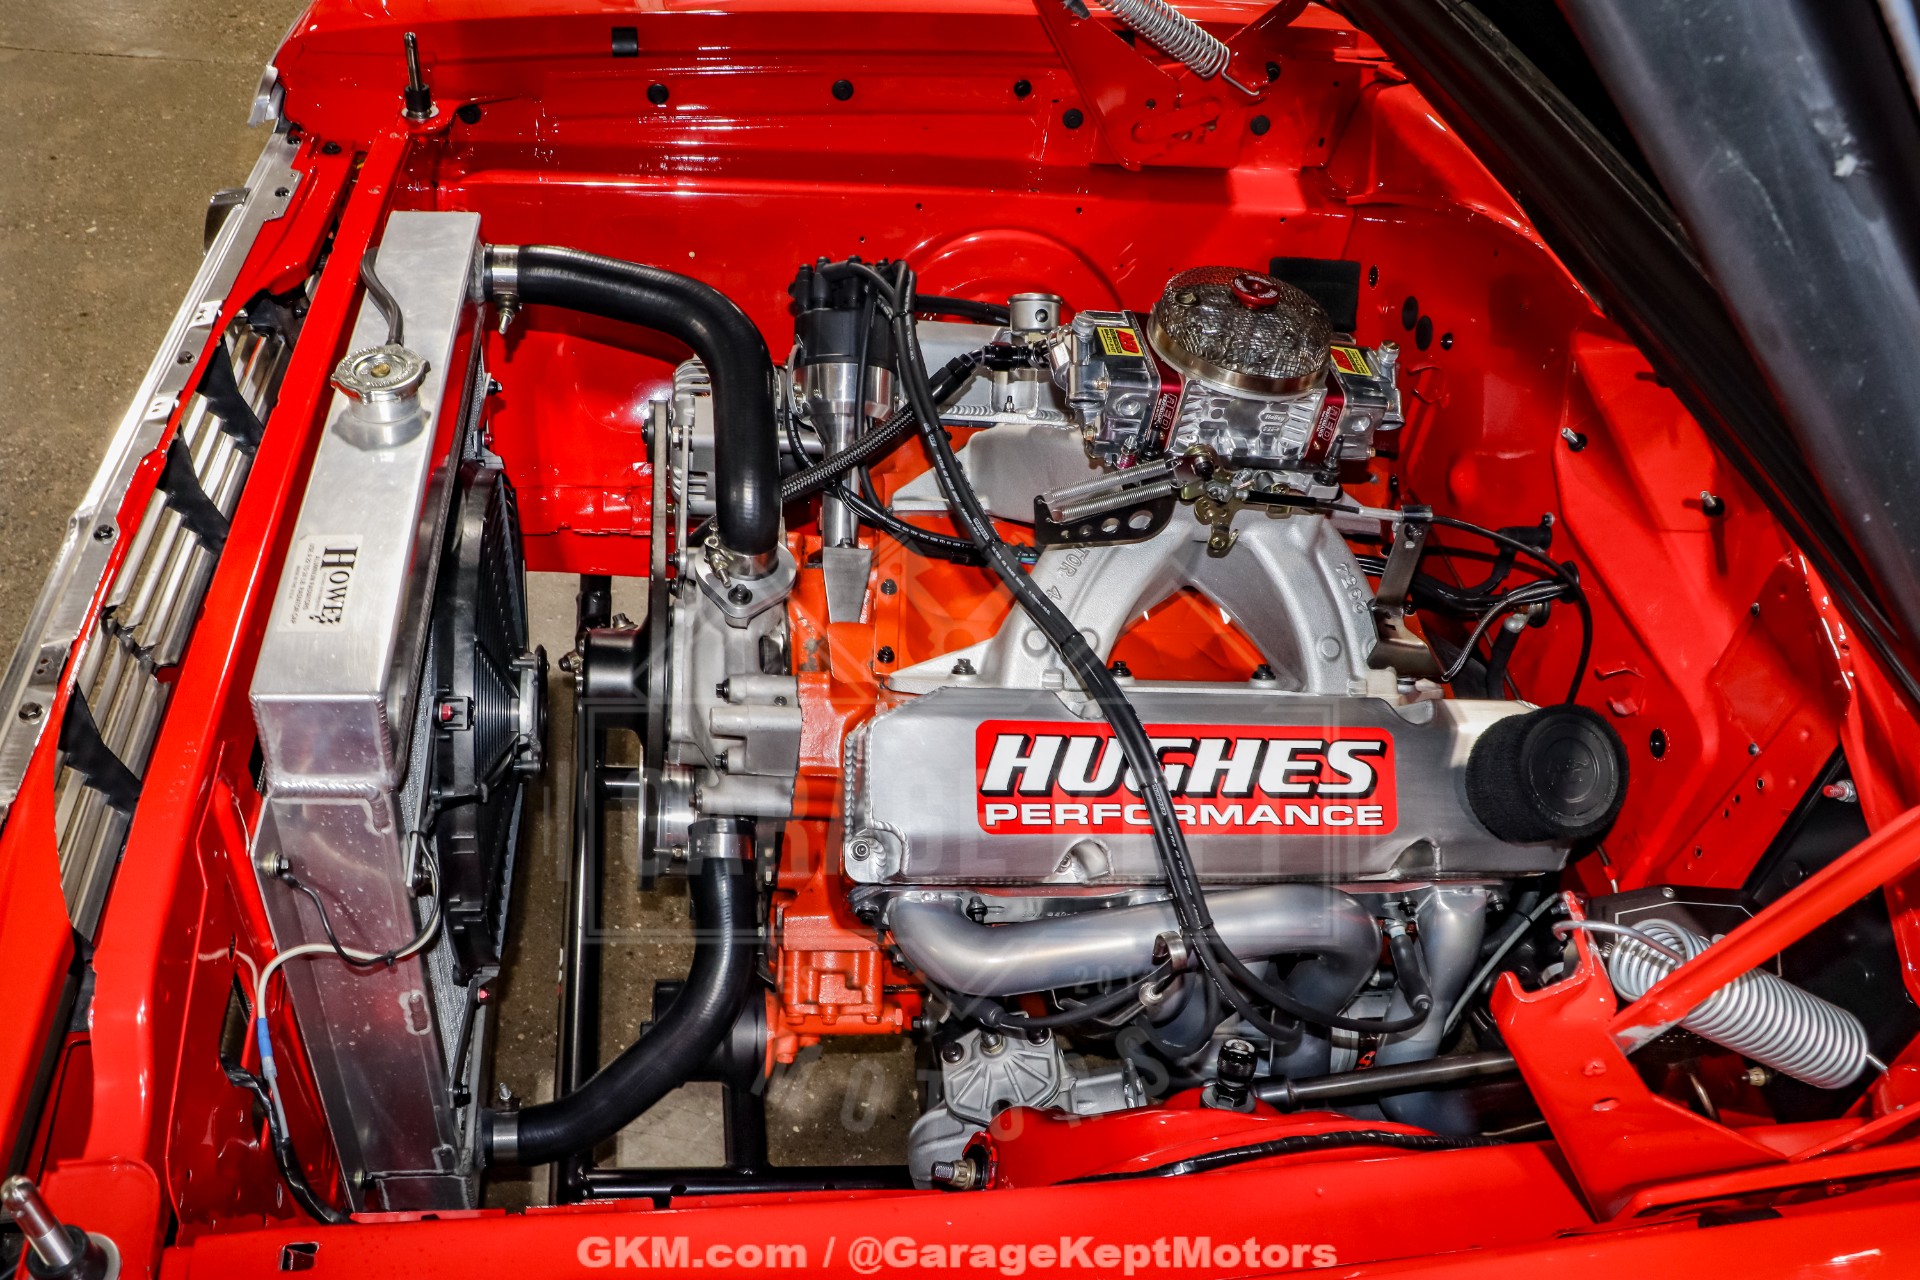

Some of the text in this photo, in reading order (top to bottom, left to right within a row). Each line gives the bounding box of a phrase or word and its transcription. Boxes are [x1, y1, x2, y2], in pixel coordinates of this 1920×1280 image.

[1265, 413, 1285, 422] Holley
[320, 546, 358, 621] HOWE
[981, 733, 1392, 798] HUGHES
[985, 802, 1384, 827] PERFORMANCE
